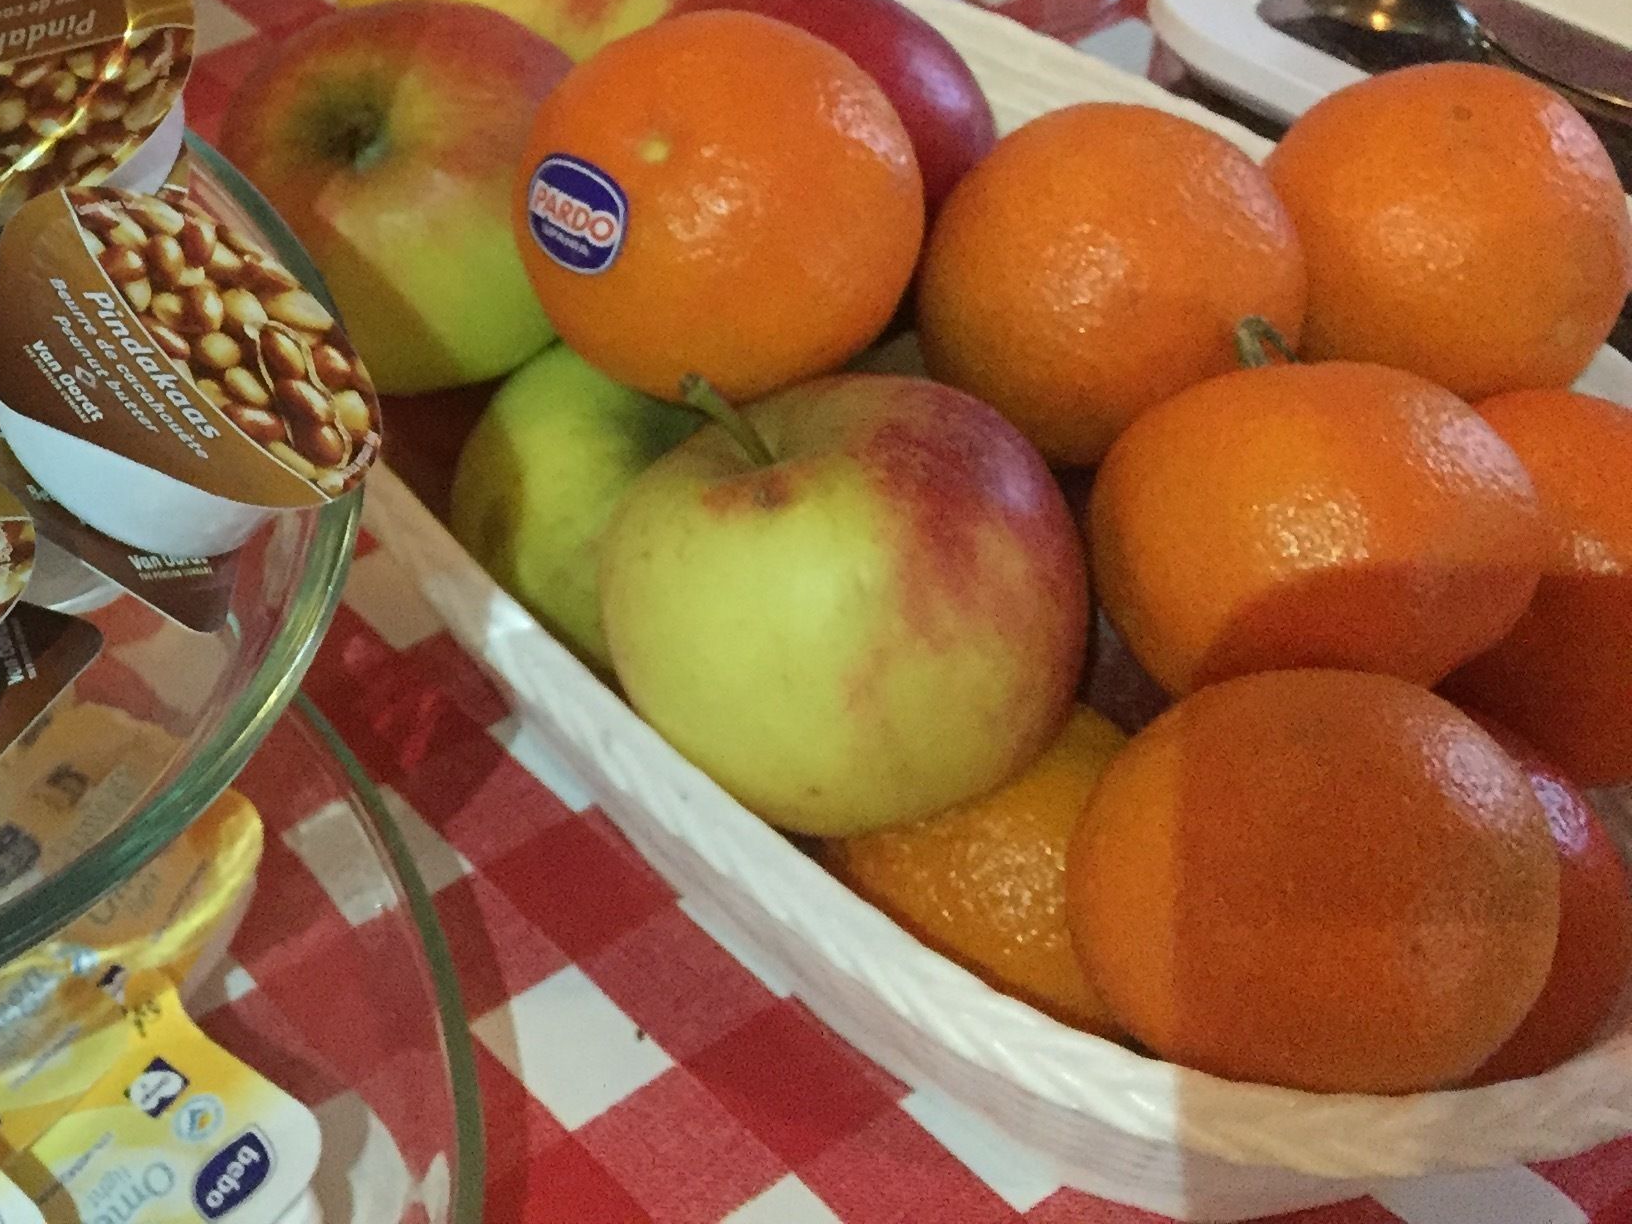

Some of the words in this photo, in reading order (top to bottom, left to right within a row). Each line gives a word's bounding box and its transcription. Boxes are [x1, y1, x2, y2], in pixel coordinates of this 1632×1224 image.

[534, 187, 616, 243] PARDO
[49, 278, 98, 336] Beurre
[95, 338, 119, 361] de
[32, 338, 64, 373] Van
[58, 372, 105, 423] Oordt
[52, 314, 110, 378] Peanut
[105, 379, 161, 434] butter
[82, 290, 222, 439] Pindakaas
[205, 1144, 261, 1210] bebo
